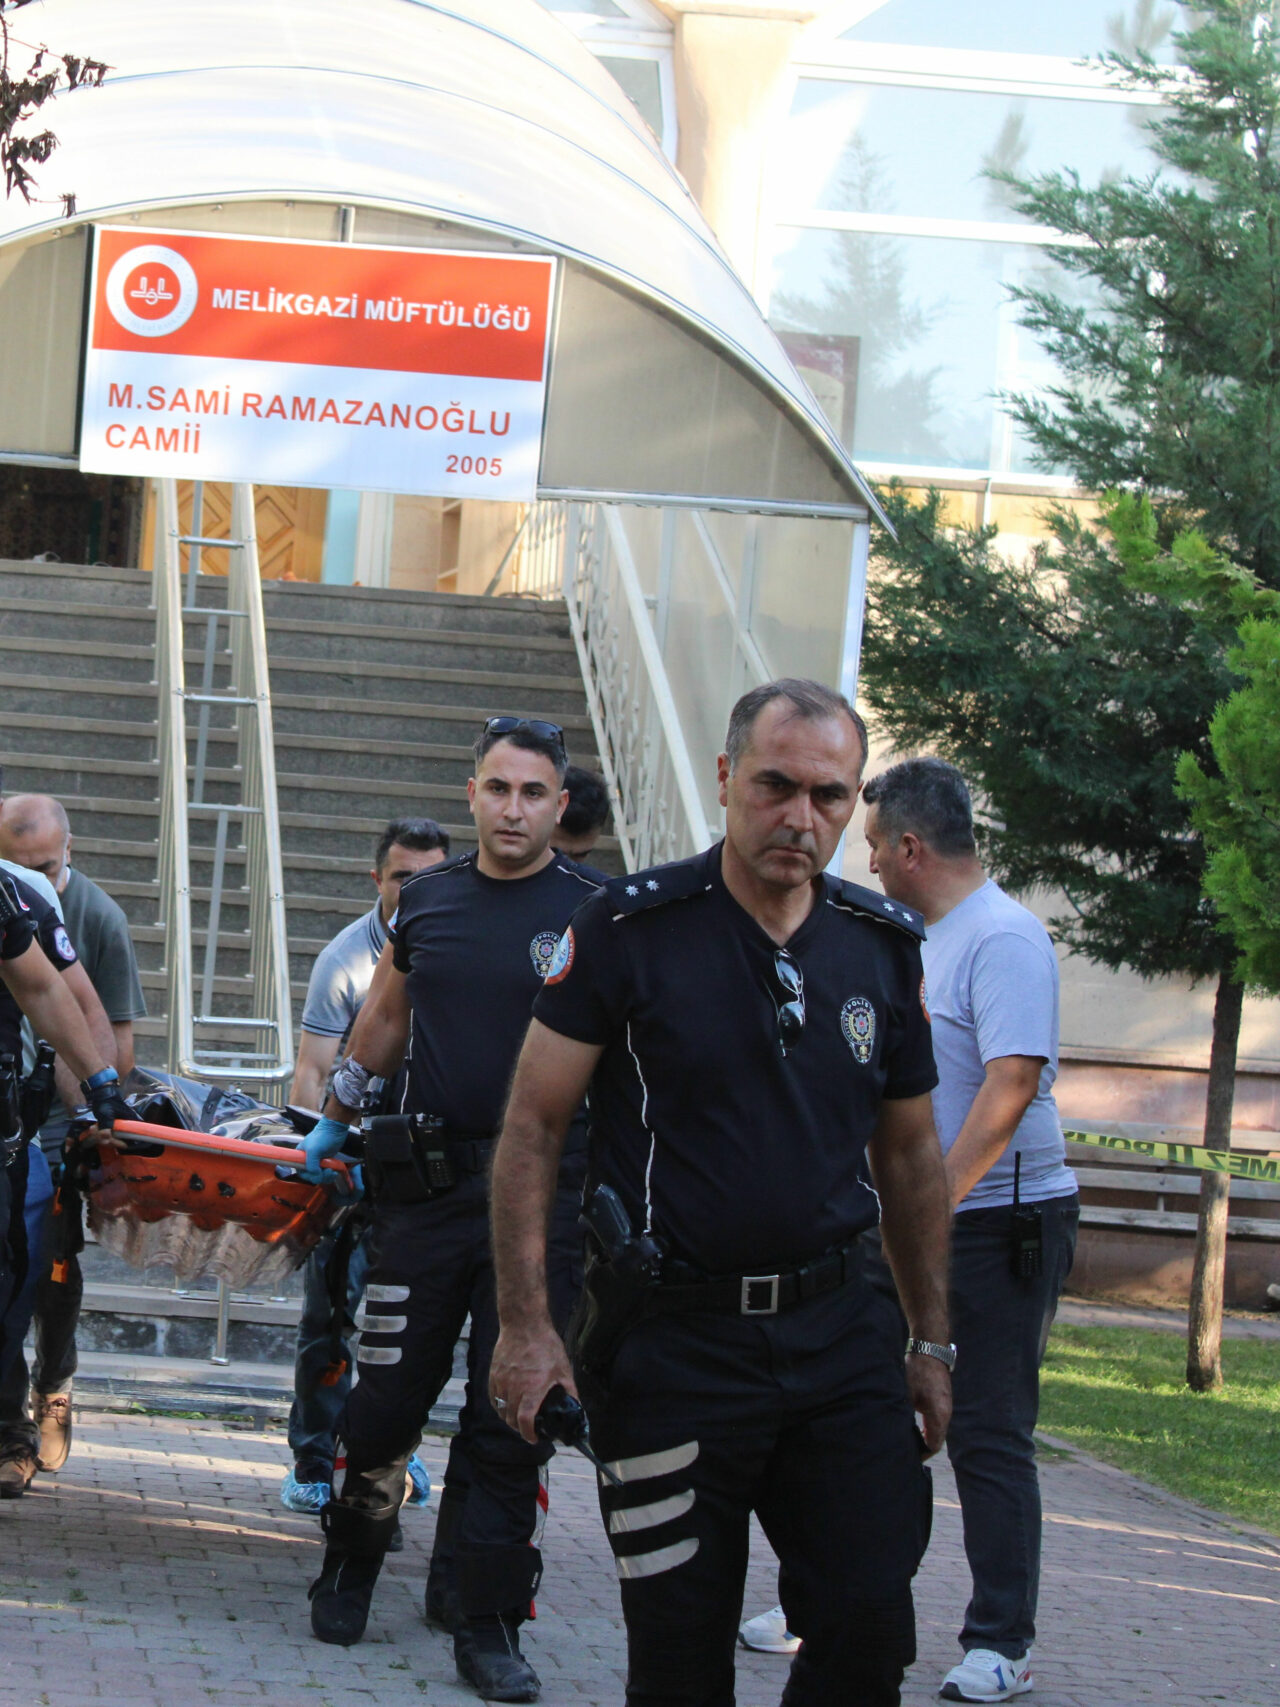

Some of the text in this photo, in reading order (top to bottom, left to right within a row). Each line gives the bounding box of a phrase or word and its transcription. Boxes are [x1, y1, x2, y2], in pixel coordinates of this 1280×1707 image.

[212, 286, 531, 332] MELİKGAZİ MÜFTÜLÜĞÜ
[107, 383, 511, 436] M.SAMİ RAMAZANOĞLU
[104, 423, 201, 454] CAMİİ
[445, 454, 503, 477] 2005
